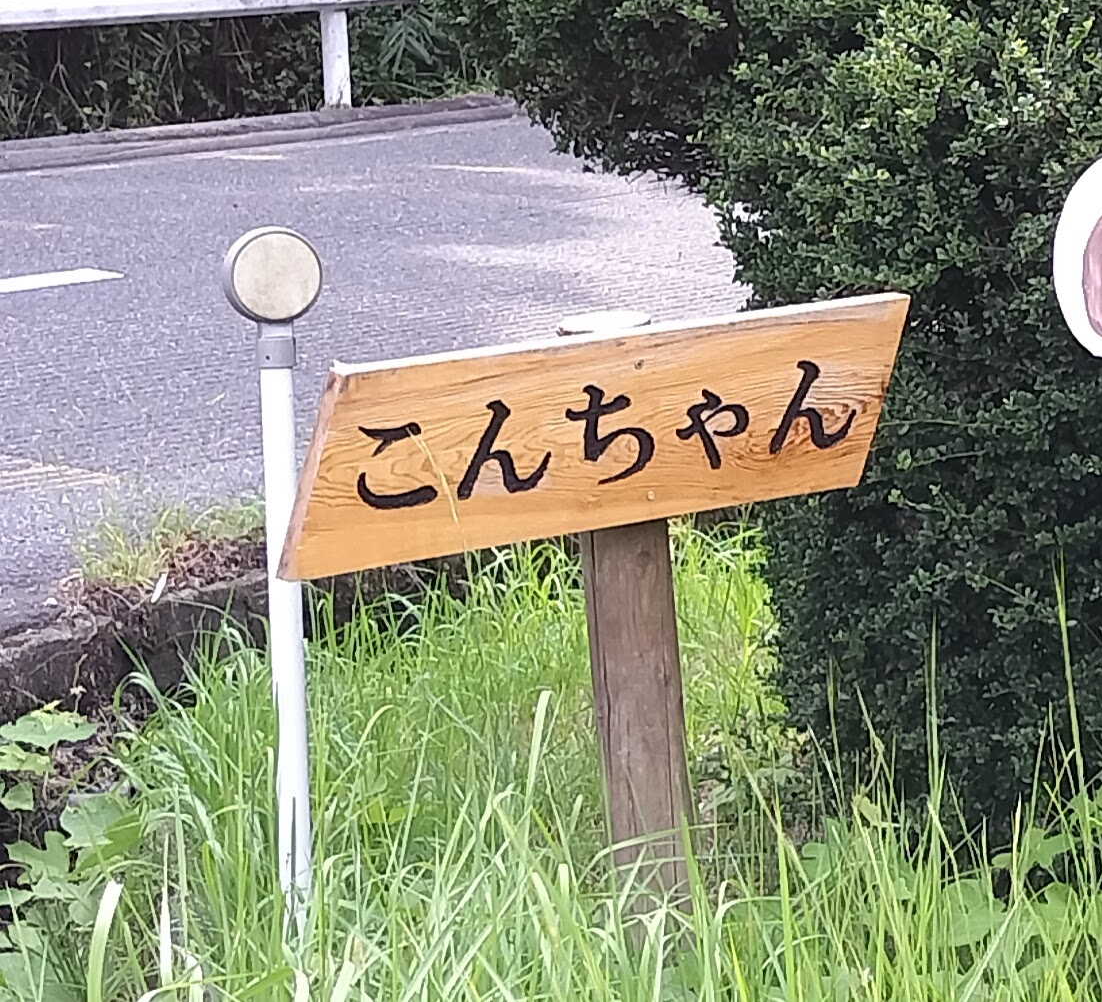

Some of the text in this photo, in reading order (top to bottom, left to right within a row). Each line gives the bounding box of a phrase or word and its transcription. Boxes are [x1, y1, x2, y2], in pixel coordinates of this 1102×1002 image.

[356, 359, 858, 511] こんちゃん
